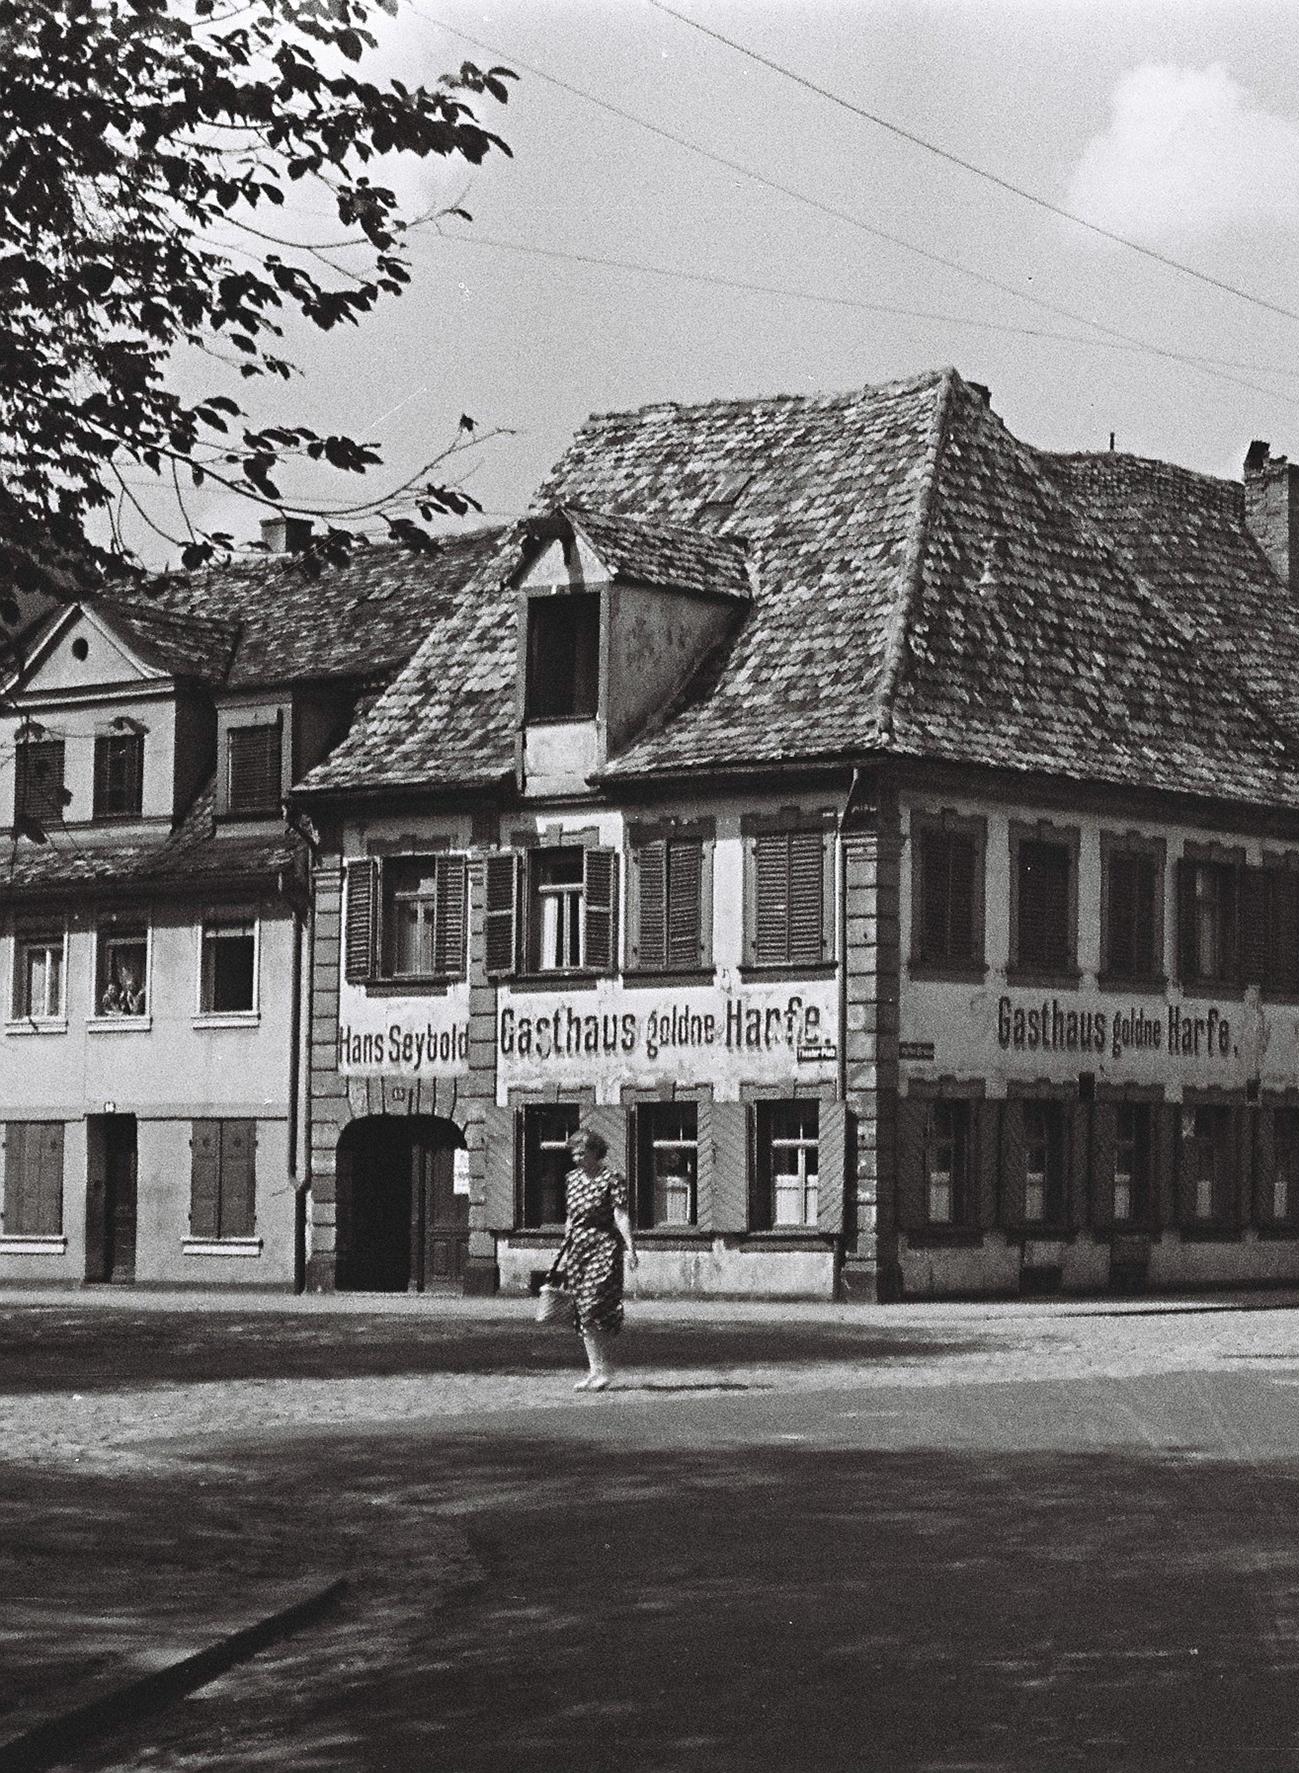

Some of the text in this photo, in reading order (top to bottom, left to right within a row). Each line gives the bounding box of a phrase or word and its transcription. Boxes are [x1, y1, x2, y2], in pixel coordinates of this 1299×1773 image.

[339, 1024, 469, 1071] Hans Seybold
[500, 1006, 636, 1059] Gasthaus
[646, 1005, 715, 1059] goldne
[998, 996, 1107, 1052] Gasthaus
[1112, 1007, 1163, 1059] goldne
